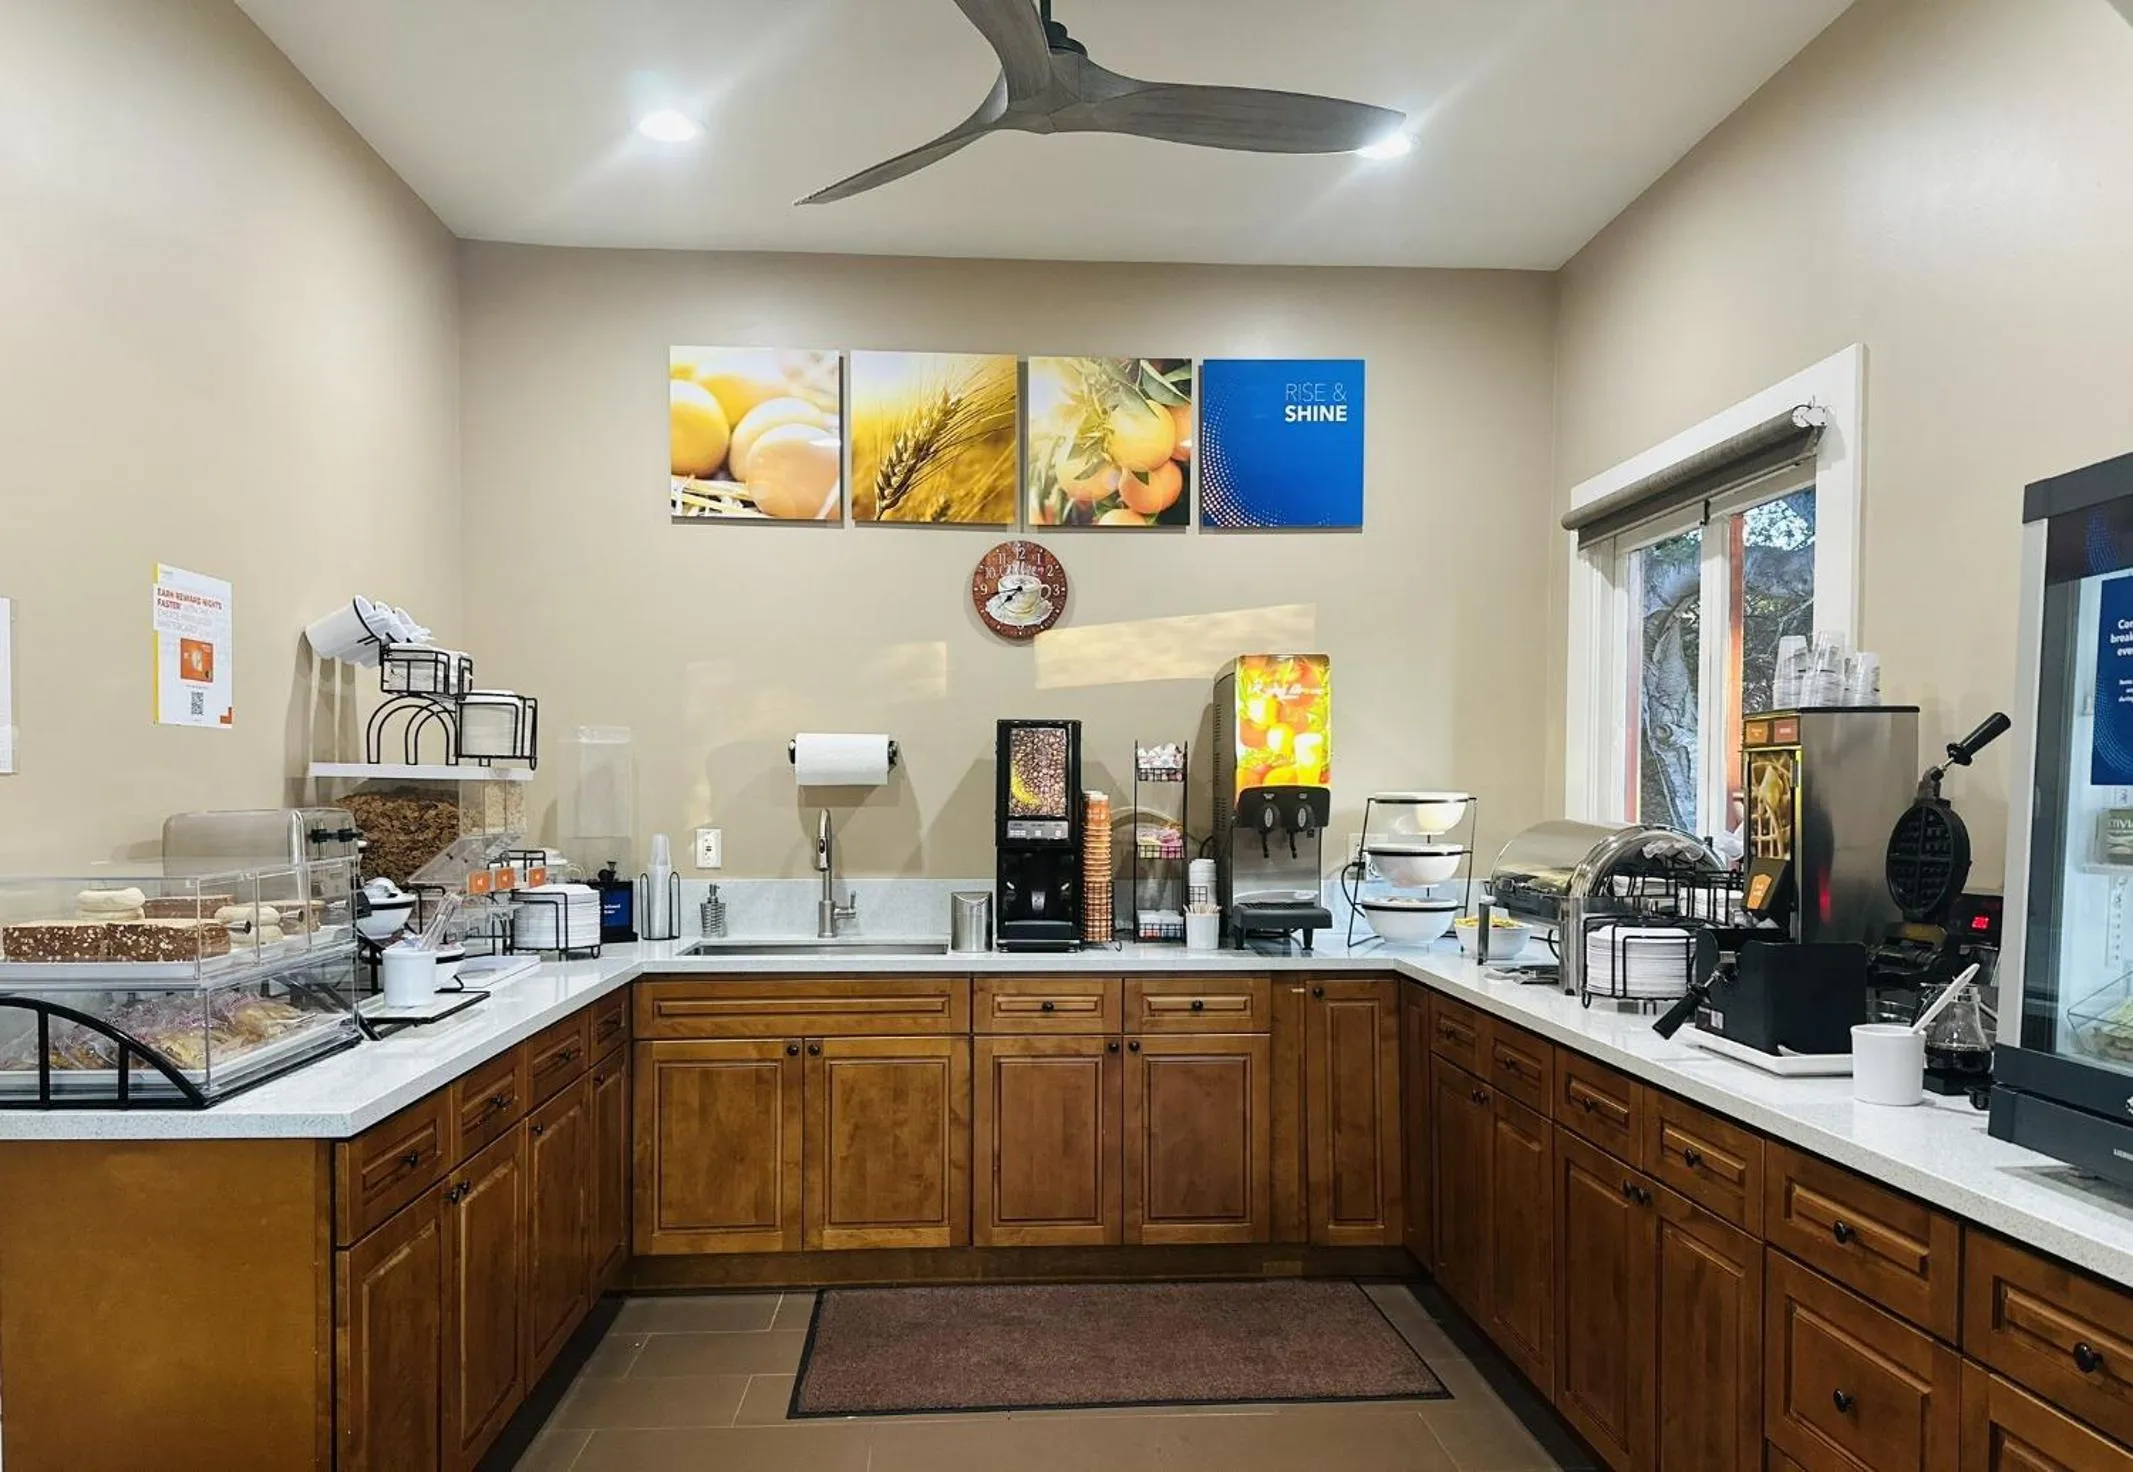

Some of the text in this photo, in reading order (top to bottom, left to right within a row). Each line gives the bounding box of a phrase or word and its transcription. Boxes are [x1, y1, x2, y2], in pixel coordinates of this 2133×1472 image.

[1286, 382, 1347, 402] RISE &
[1285, 405, 1348, 422] SHINE
[1016, 547, 1026, 560] 12
[999, 553, 1006, 568] 11
[986, 566, 996, 579] 10
[1047, 564, 1054, 577] 2
[980, 583, 988, 595] 9
[1053, 584, 1060, 596] 3
[157, 587, 222, 610] EARN REWARD NIGHTS
[157, 598, 181, 610] FASTER
